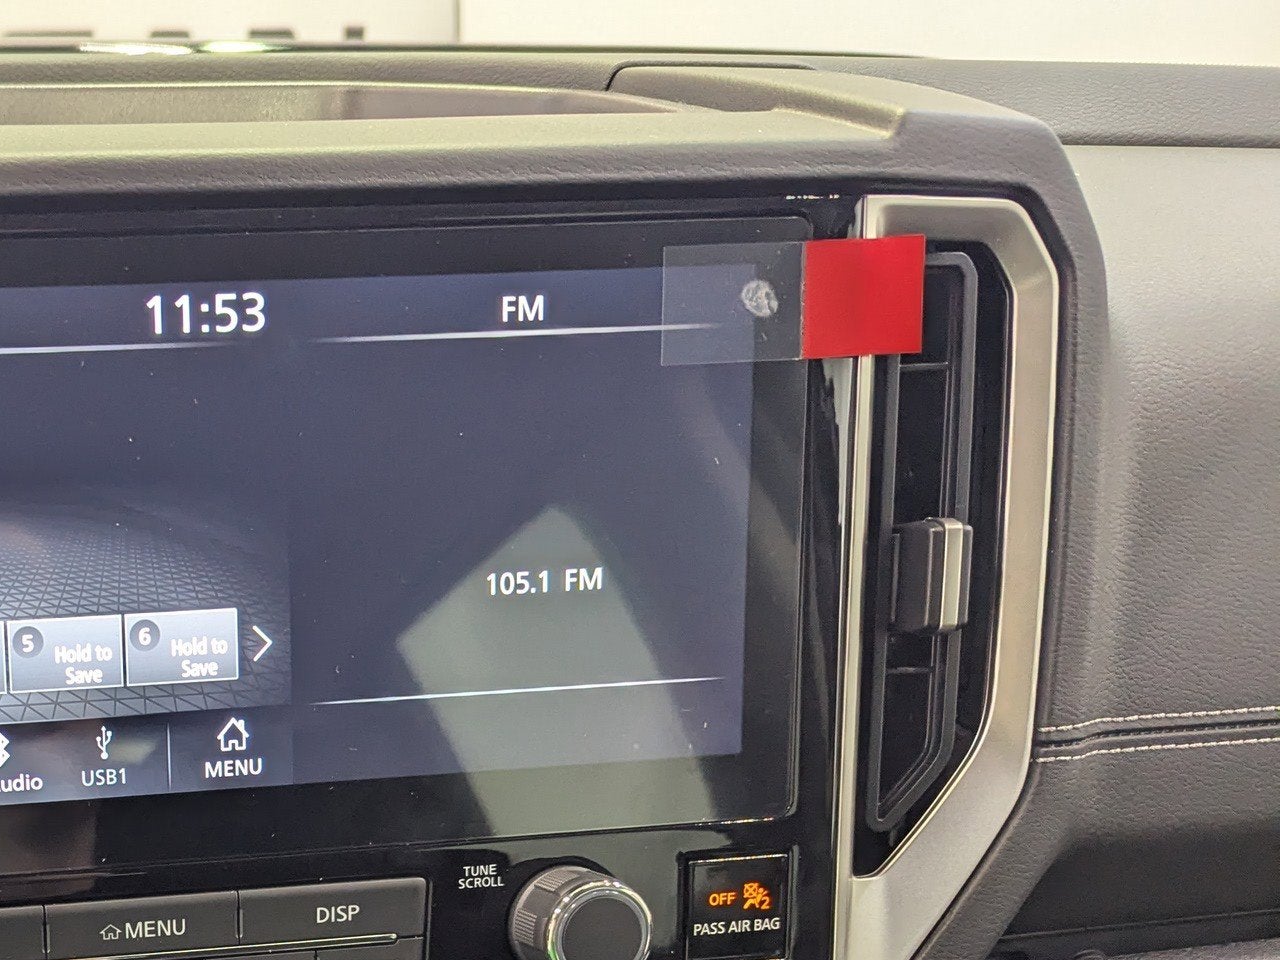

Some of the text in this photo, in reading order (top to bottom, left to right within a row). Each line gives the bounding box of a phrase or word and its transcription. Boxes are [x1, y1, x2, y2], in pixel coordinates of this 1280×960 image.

[146, 292, 266, 335] 11:53
[500, 295, 544, 323] FM
[486, 568, 603, 596] 105.1 FM
[22, 635, 34, 653] 5
[138, 628, 152, 646] 6
[55, 645, 112, 664] Hold to
[171, 637, 227, 657] Hold to
[65, 667, 102, 685] Save
[181, 660, 218, 678] Save
[81, 768, 126, 787] USB1
[205, 758, 263, 779] MENU
[463, 864, 497, 877] TUNE
[458, 874, 504, 889] SCROLL
[709, 892, 736, 906] OFF
[316, 905, 360, 924] DISP
[125, 919, 186, 939] MENU
[693, 918, 780, 936] PASS AIR BAG
